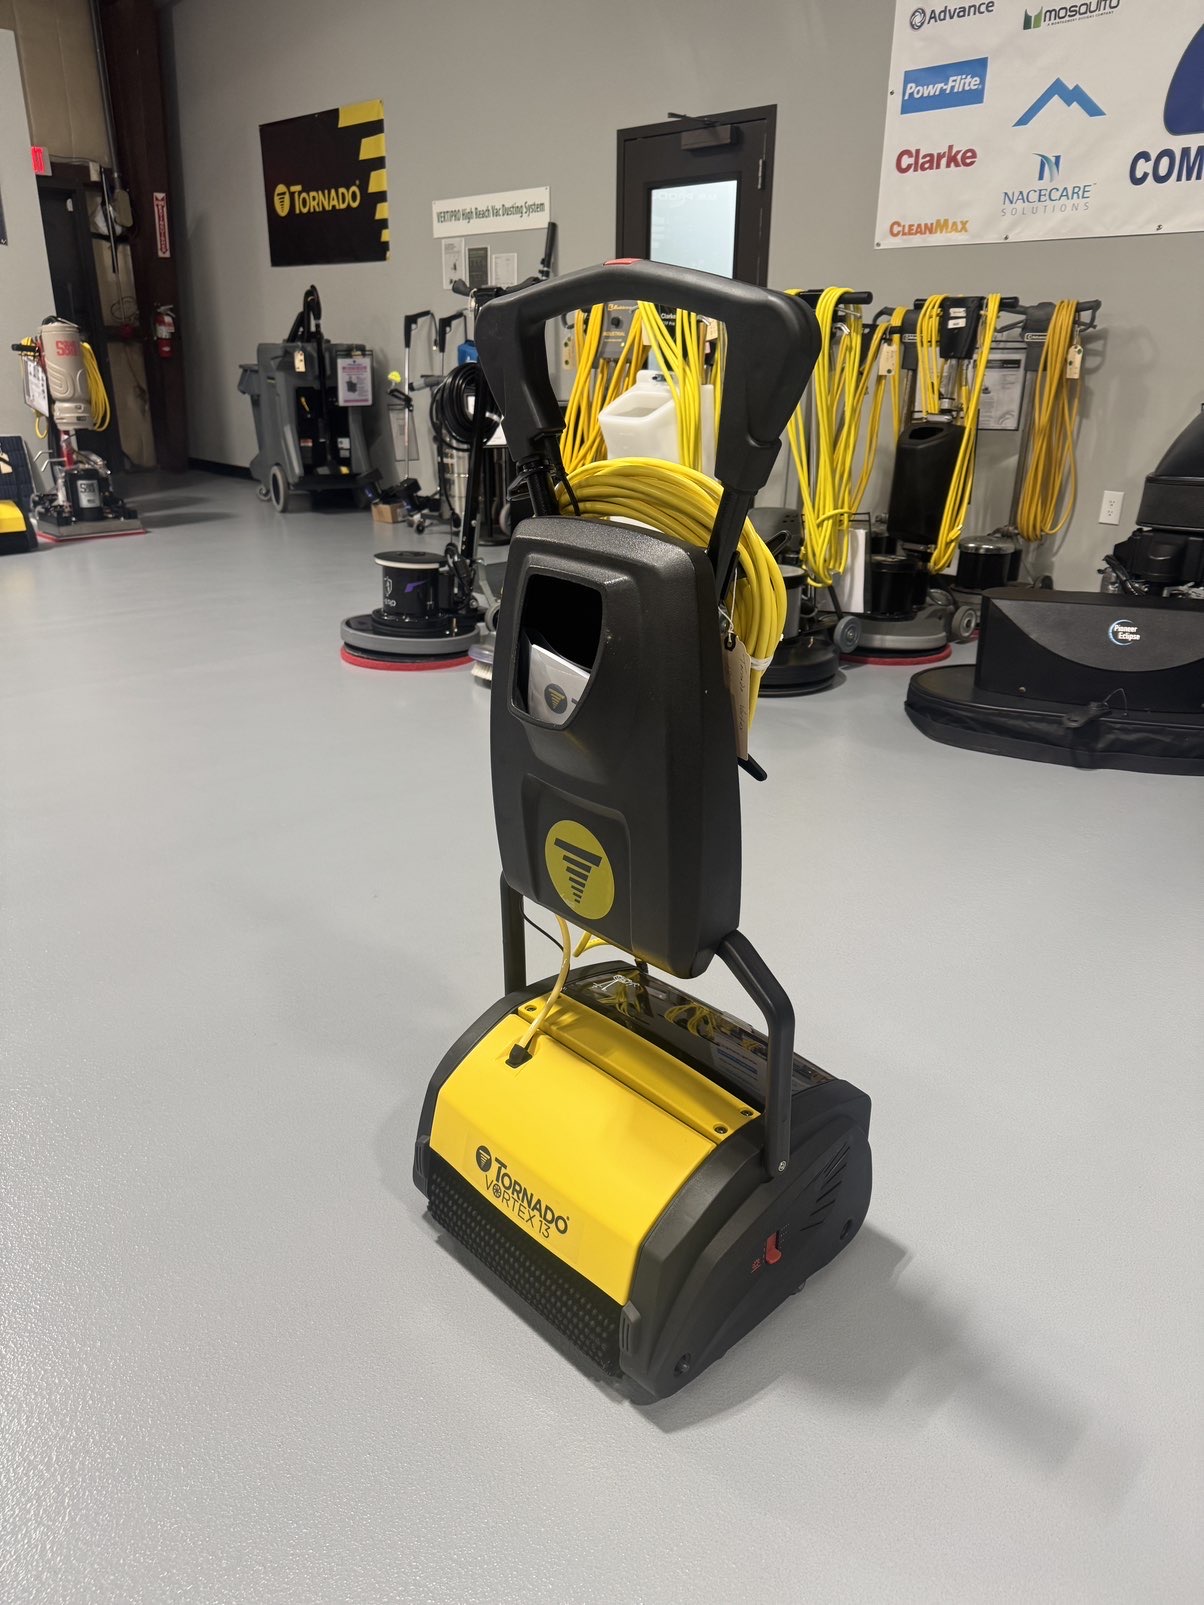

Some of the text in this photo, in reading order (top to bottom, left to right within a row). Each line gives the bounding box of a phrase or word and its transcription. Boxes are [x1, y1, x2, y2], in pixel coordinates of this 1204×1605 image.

[927, 1, 995, 25] Advance
[904, 74, 981, 100] Powr-Flite
[895, 144, 978, 174] Clarke
[1129, 146, 1204, 186] COM
[1002, 185, 1092, 206] NACECARE
[462, 208, 474, 223] High
[474, 205, 491, 219] Reach
[491, 205, 501, 218] Vac
[502, 202, 524, 218] Dusting
[524, 201, 545, 217] System
[1001, 202, 1090, 217] SOLUTIONS
[1114, 624, 1138, 633] Pioneer
[1118, 632, 1141, 641] Eclipse
[485, 1174, 551, 1239] VORTEX 13
